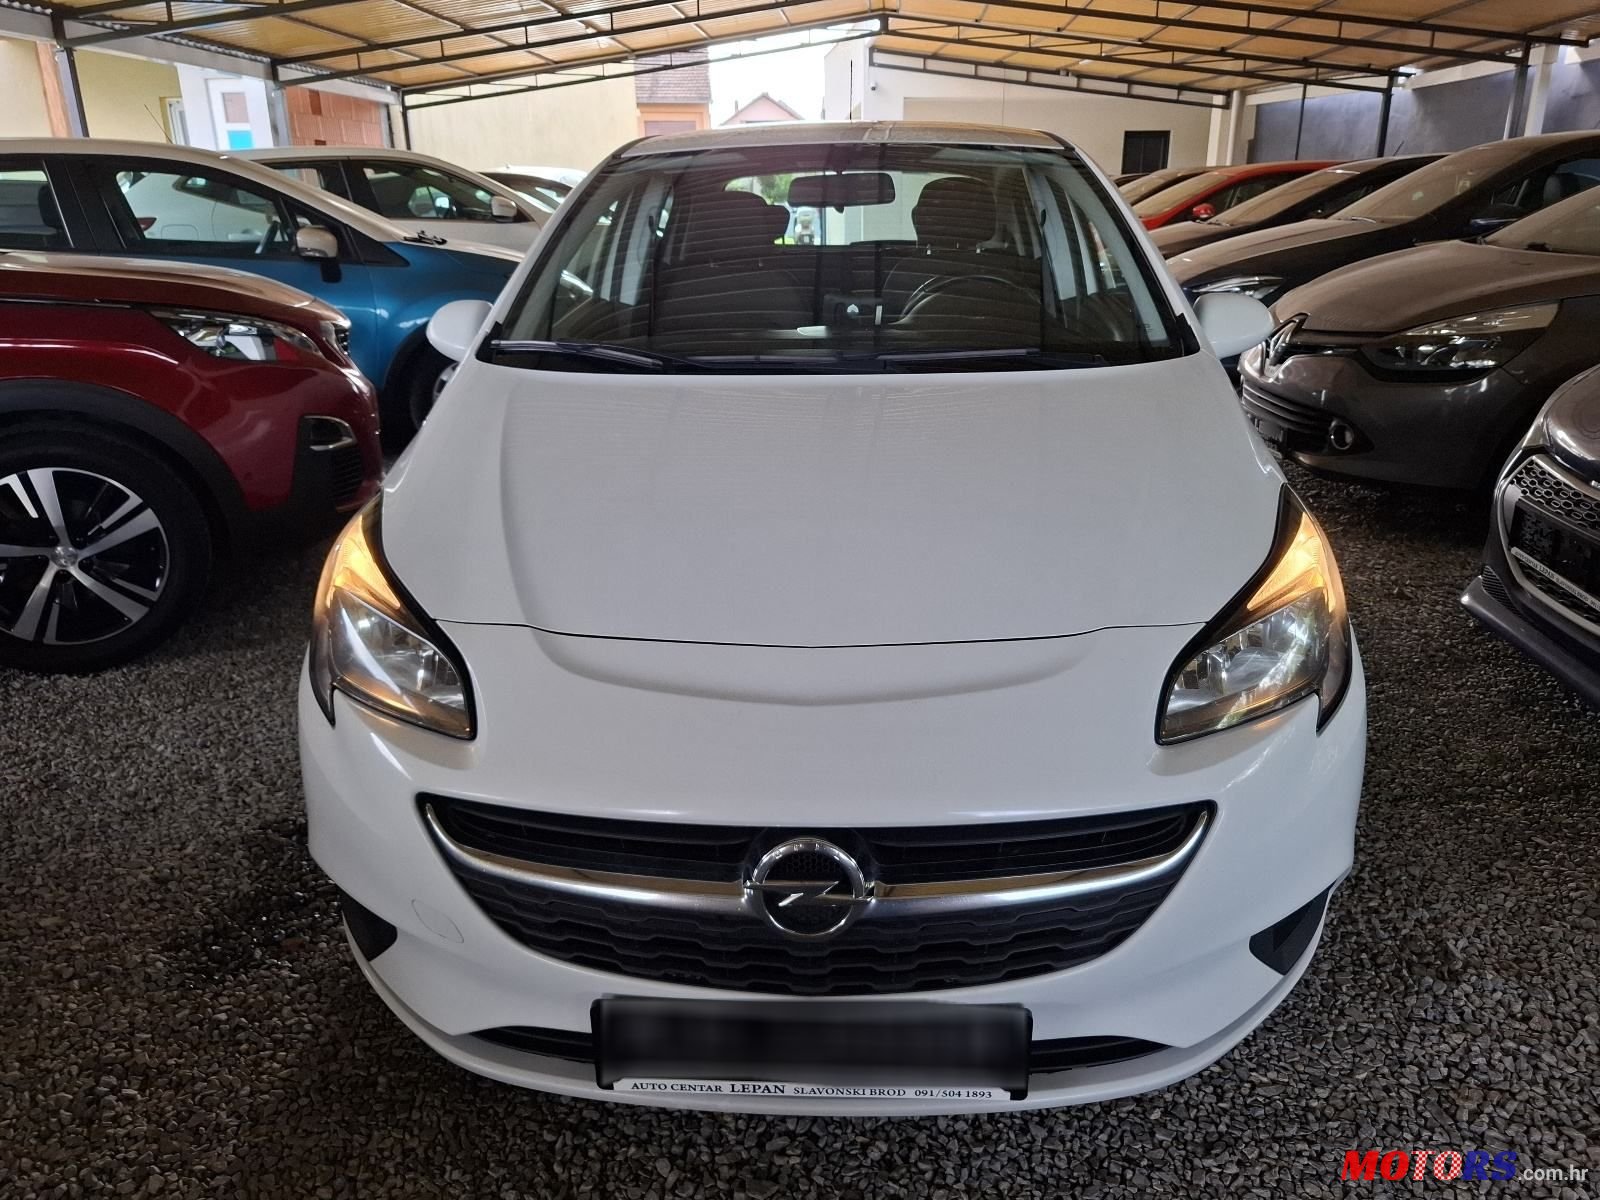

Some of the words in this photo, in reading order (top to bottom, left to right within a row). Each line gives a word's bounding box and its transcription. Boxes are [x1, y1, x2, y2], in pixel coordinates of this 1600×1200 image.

[631, 1082, 668, 1091] AUTO
[670, 1083, 723, 1093] CENTAR
[730, 1083, 786, 1094] LEPAN
[793, 1086, 866, 1096] SLAVONSKI
[869, 1088, 907, 1097] BROD
[914, 1088, 962, 1098] 091/504
[965, 1090, 993, 1099] 1893
